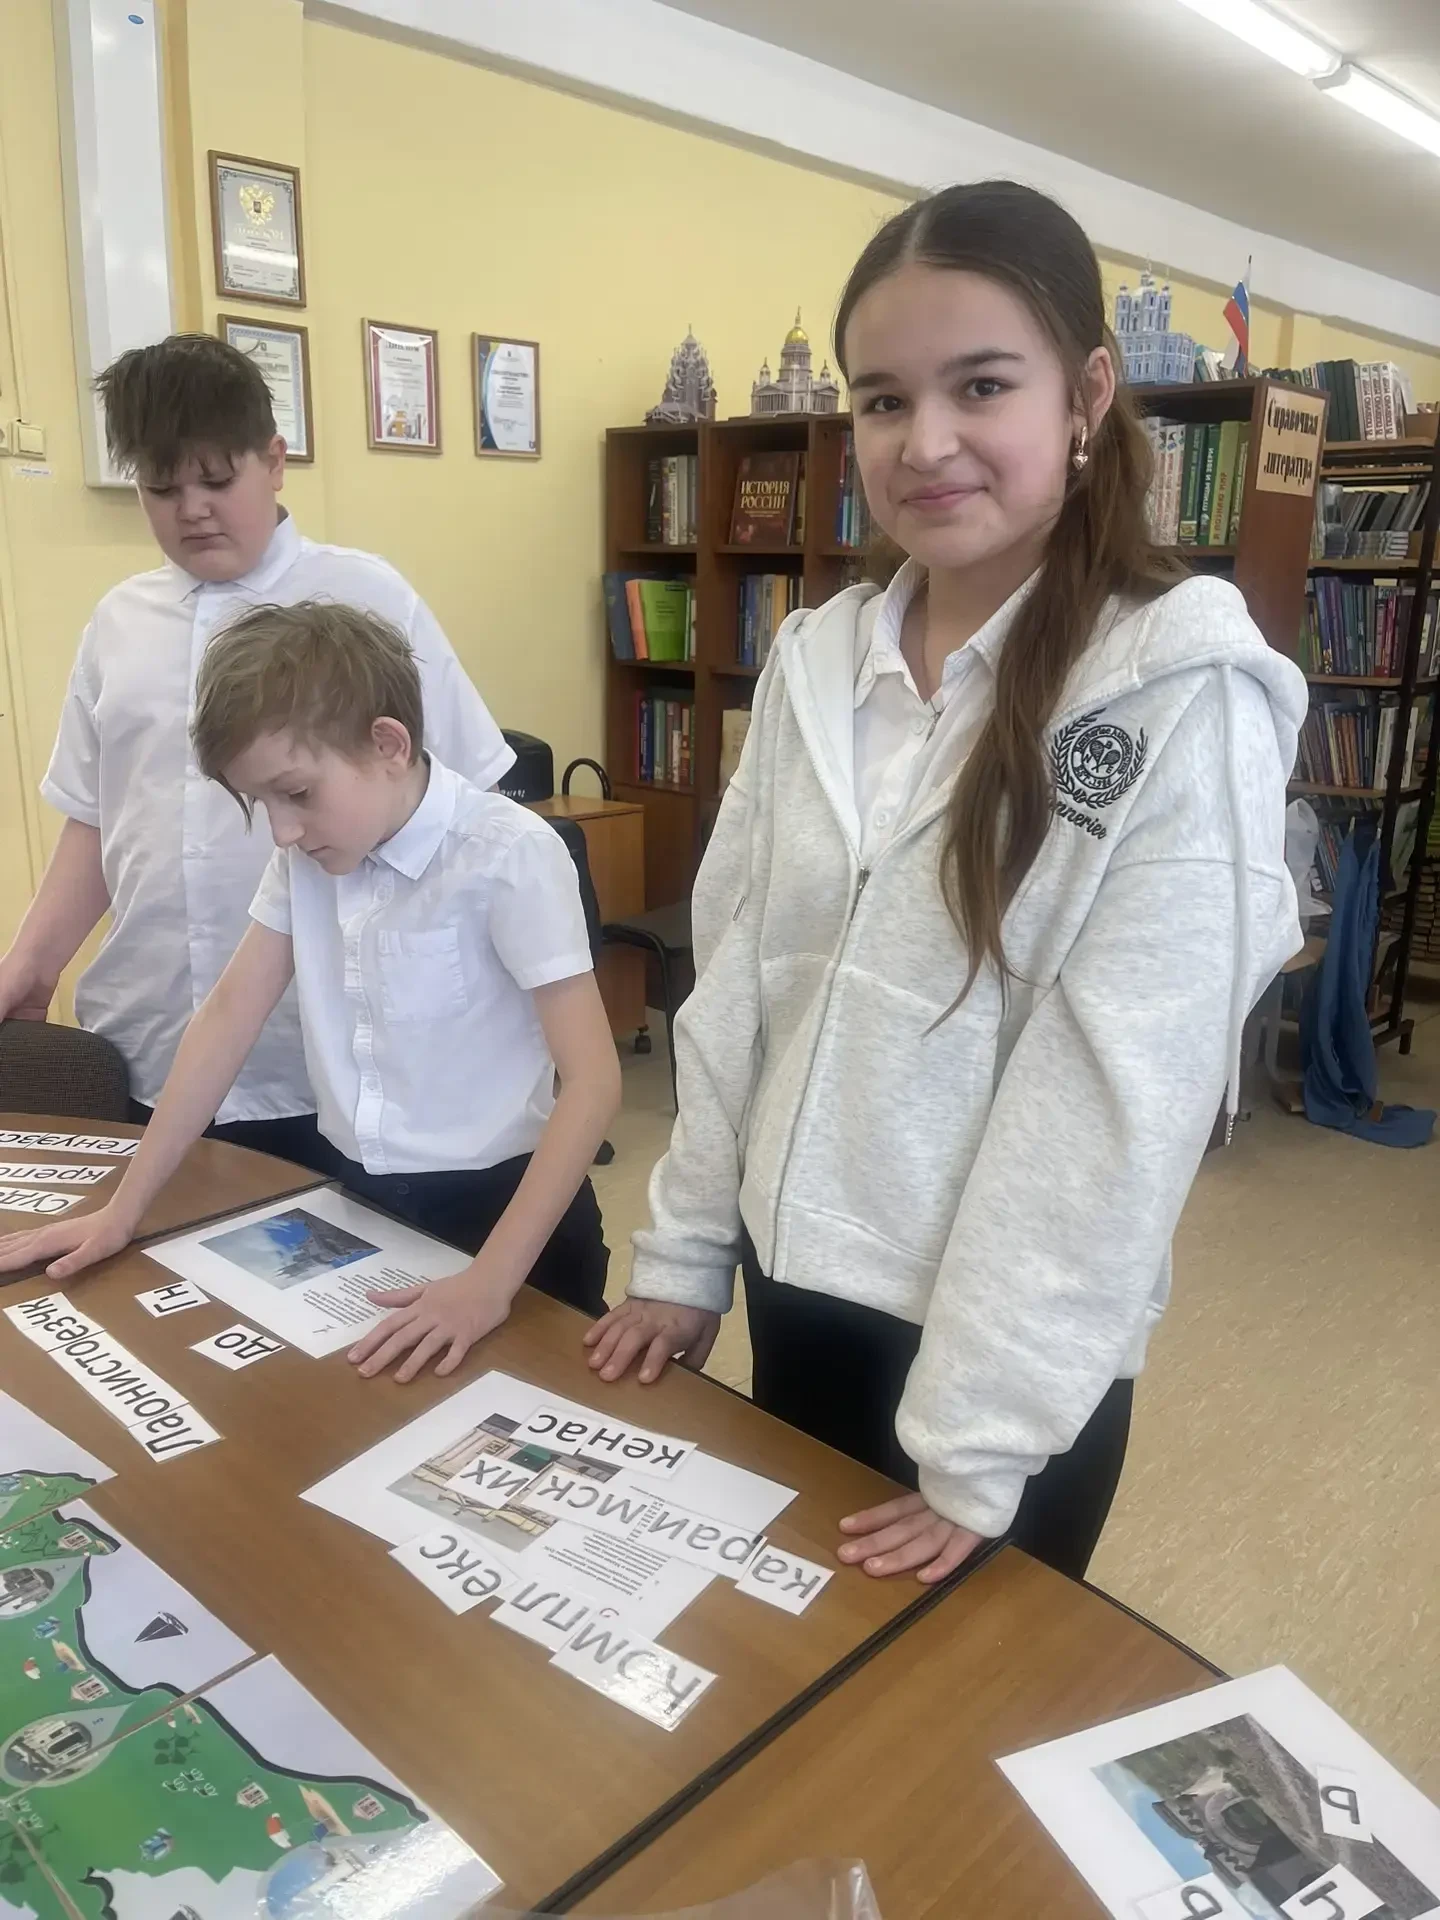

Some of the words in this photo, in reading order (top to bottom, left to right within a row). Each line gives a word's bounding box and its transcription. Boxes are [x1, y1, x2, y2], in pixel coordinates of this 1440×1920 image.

[741, 480, 790, 495] ИСТОРИЯ
[740, 495, 786, 510] РОССИИ
[0, 1131, 139, 1156] Генуэзс
[0, 1190, 69, 1213] Суд
